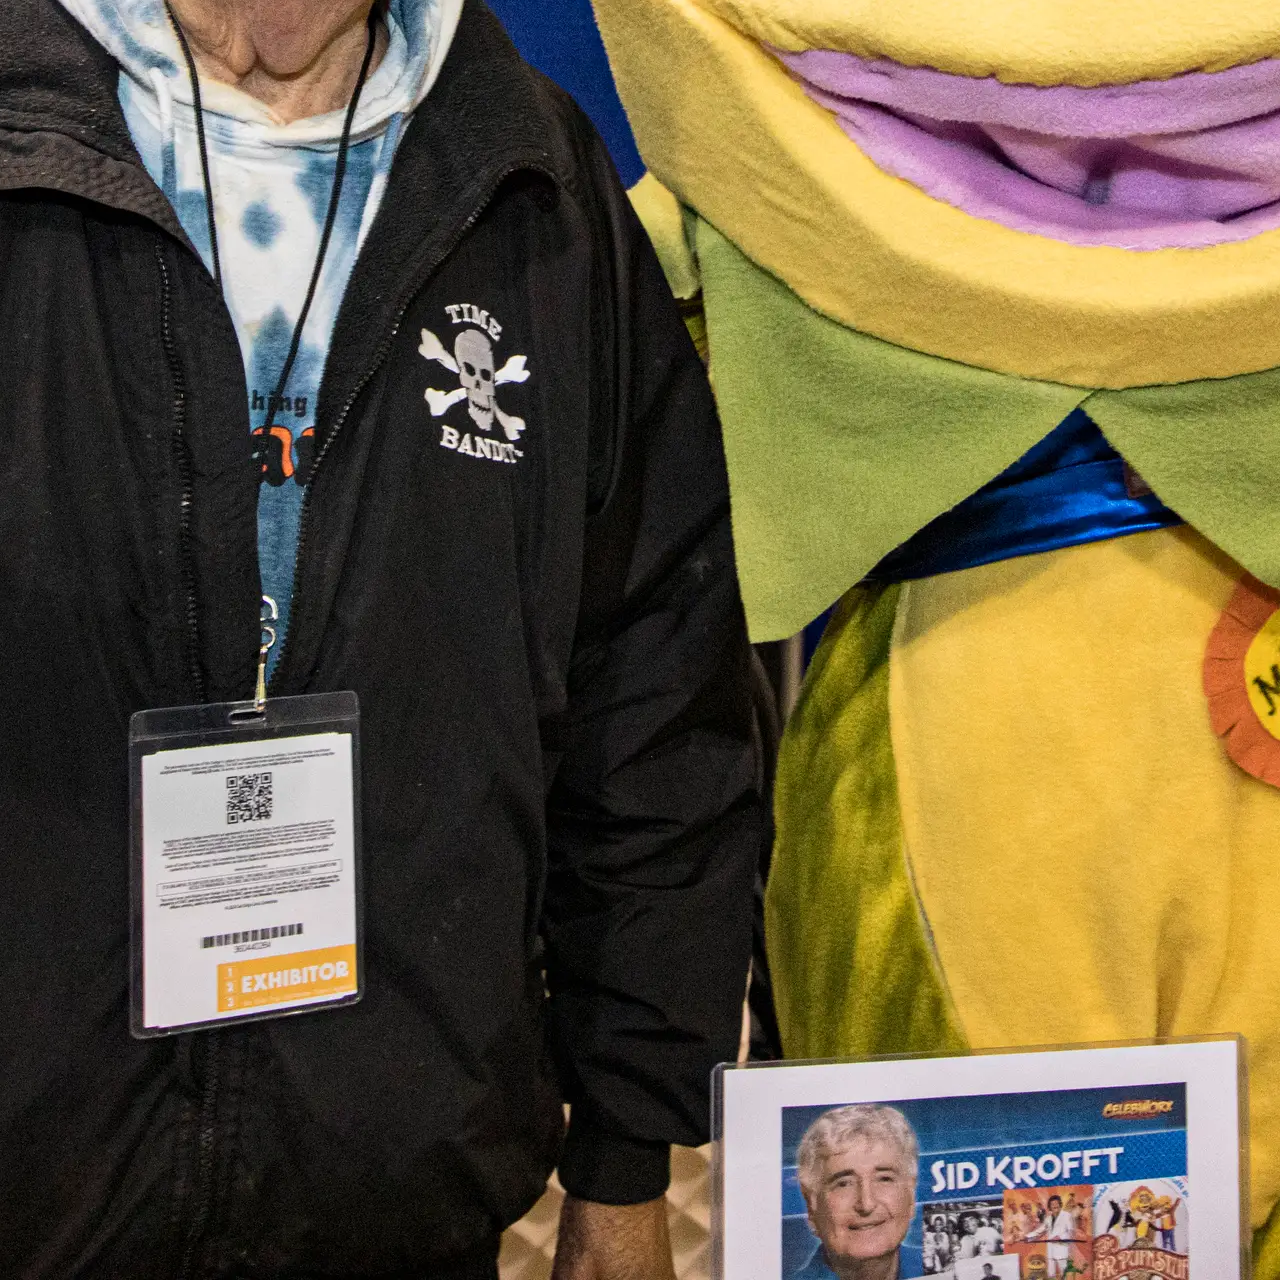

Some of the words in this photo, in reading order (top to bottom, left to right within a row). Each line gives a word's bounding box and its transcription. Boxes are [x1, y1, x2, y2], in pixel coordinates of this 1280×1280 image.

[444, 303, 503, 342] TIME
[241, 960, 349, 994] EXHIBITOR
[931, 1160, 980, 1193] SID
[986, 1146, 1125, 1190] KROFFT
